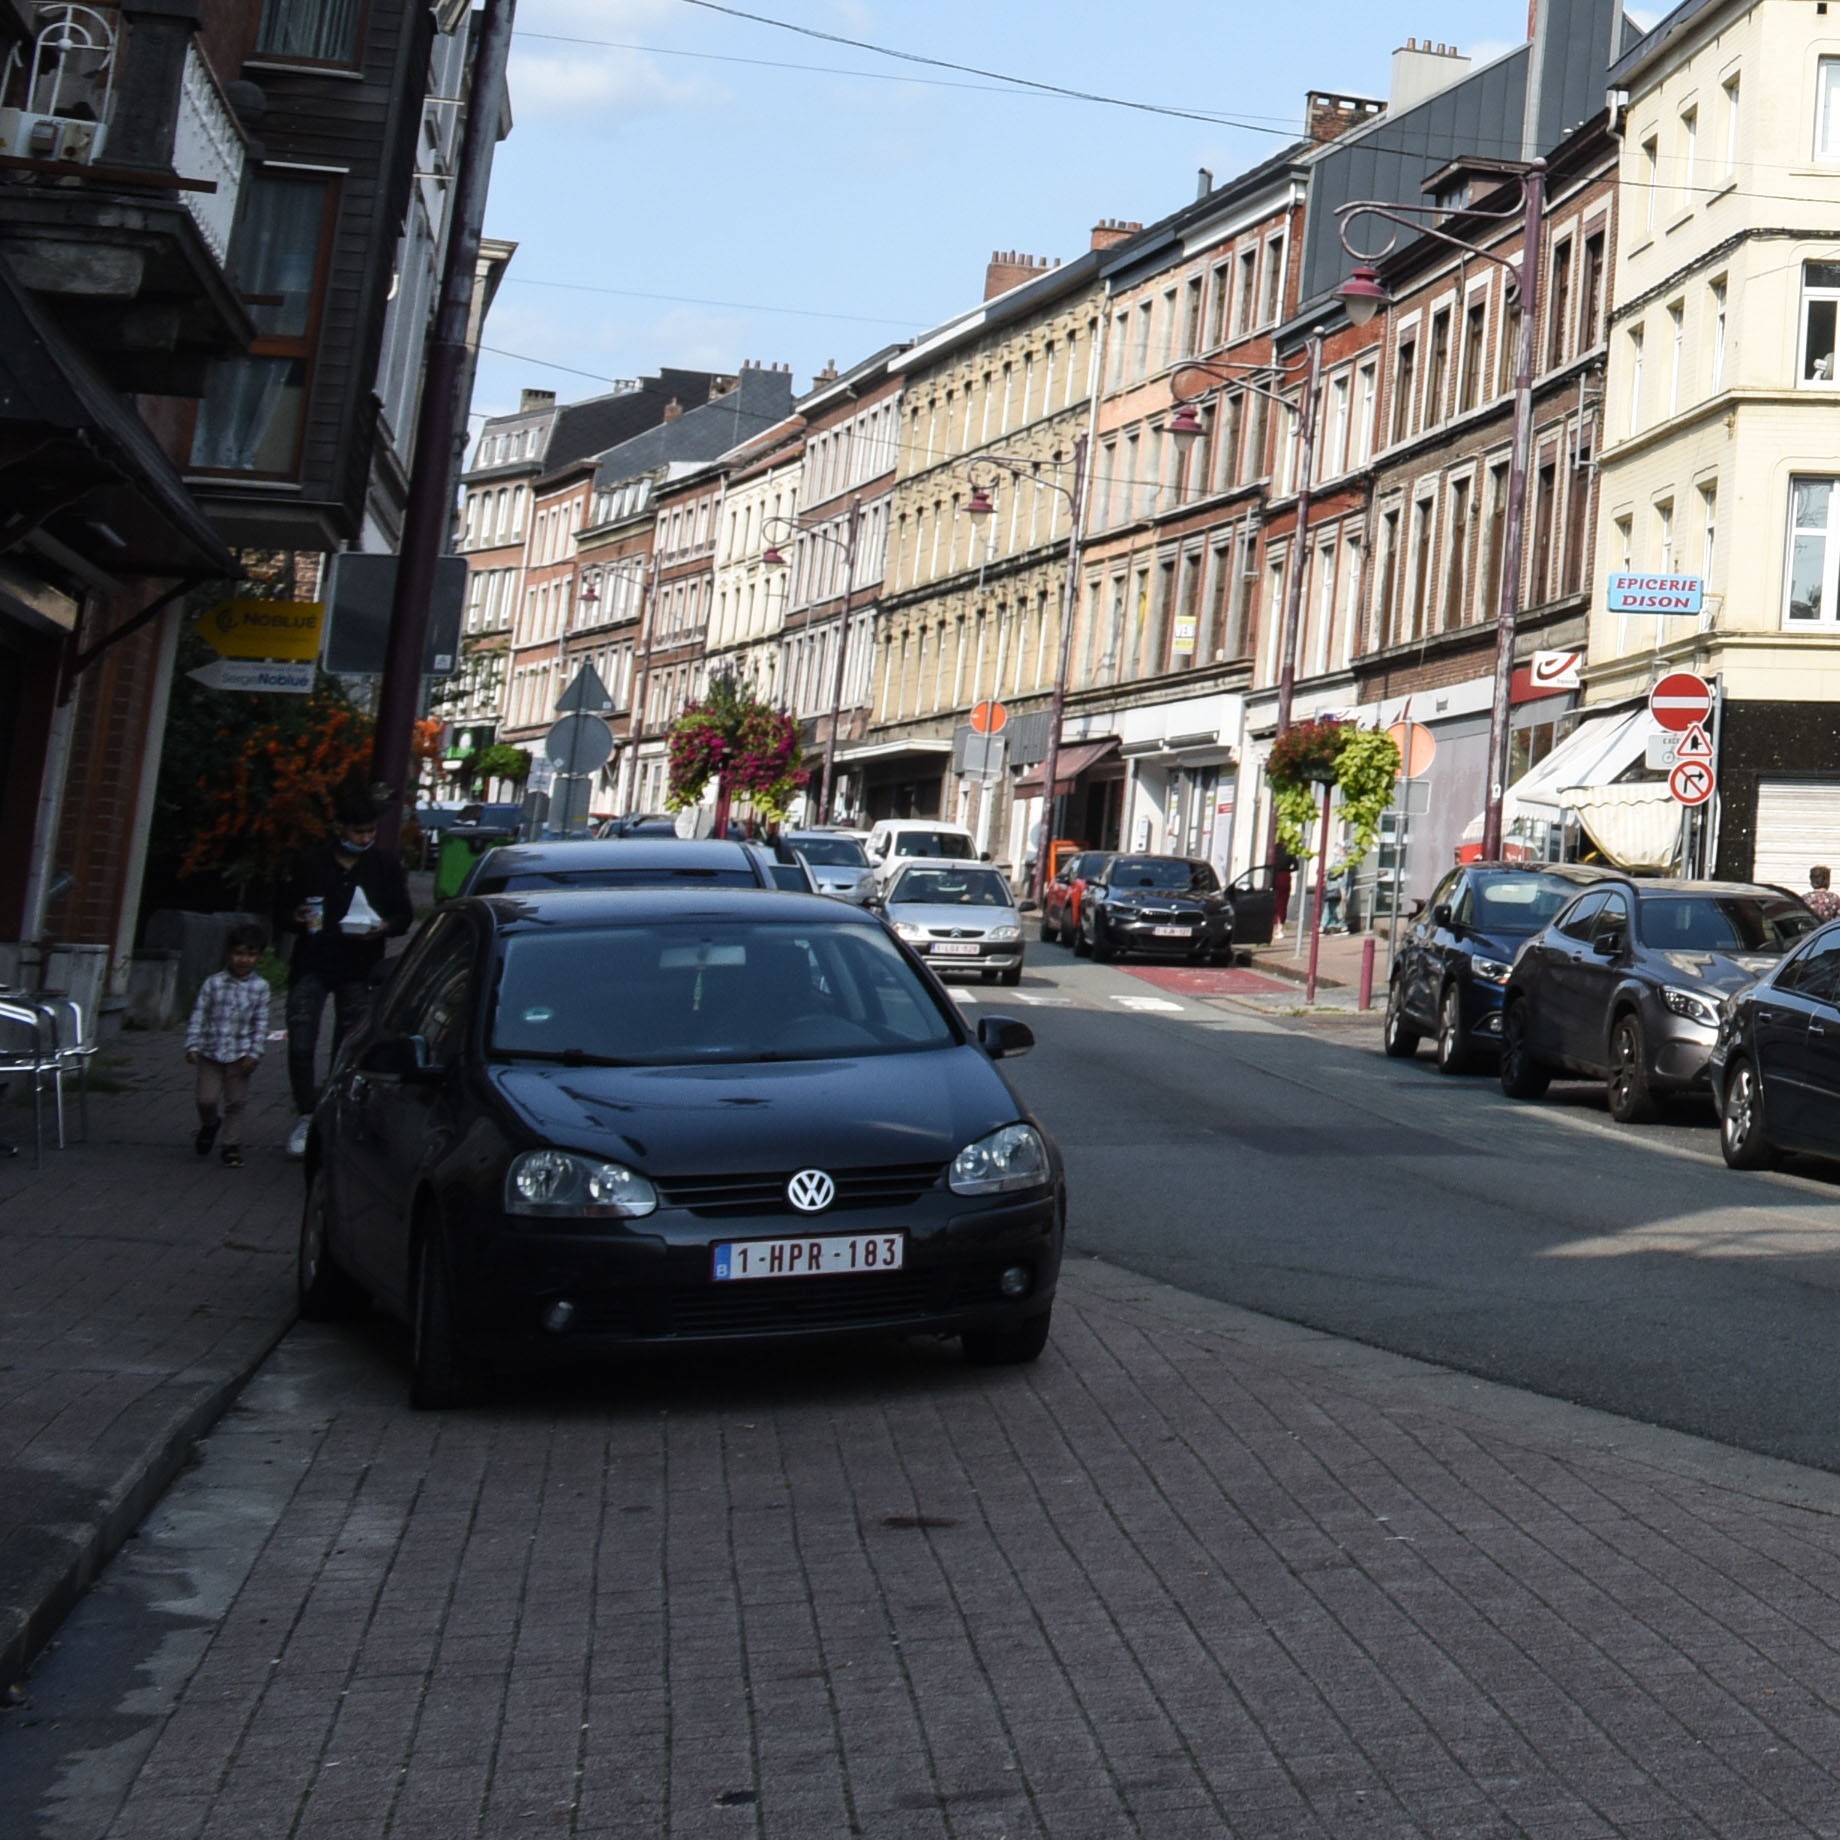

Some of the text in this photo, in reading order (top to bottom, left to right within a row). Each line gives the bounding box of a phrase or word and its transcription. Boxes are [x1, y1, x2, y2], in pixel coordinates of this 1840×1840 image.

[1616, 577, 1698, 592] EPICERIE
[1621, 594, 1690, 608] DISON
[737, 1237, 897, 1274] 1-HPR-183
